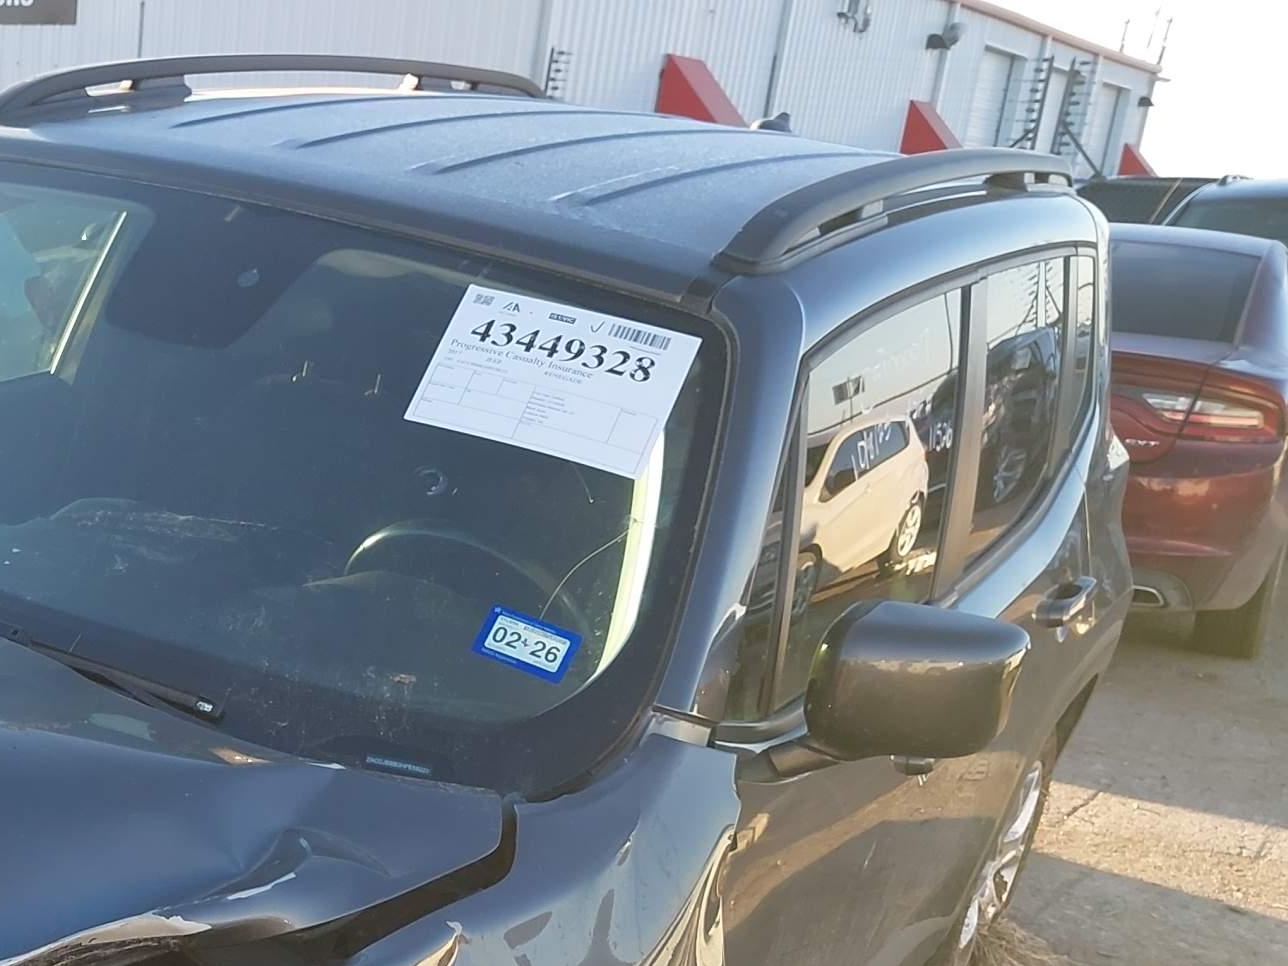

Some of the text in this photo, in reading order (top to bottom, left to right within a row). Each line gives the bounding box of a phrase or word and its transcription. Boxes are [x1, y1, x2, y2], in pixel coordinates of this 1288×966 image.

[450, 338, 504, 358] Progressive
[504, 350, 546, 369] Casualty
[547, 360, 594, 379] Insurance
[470, 319, 656, 383] 43449328
